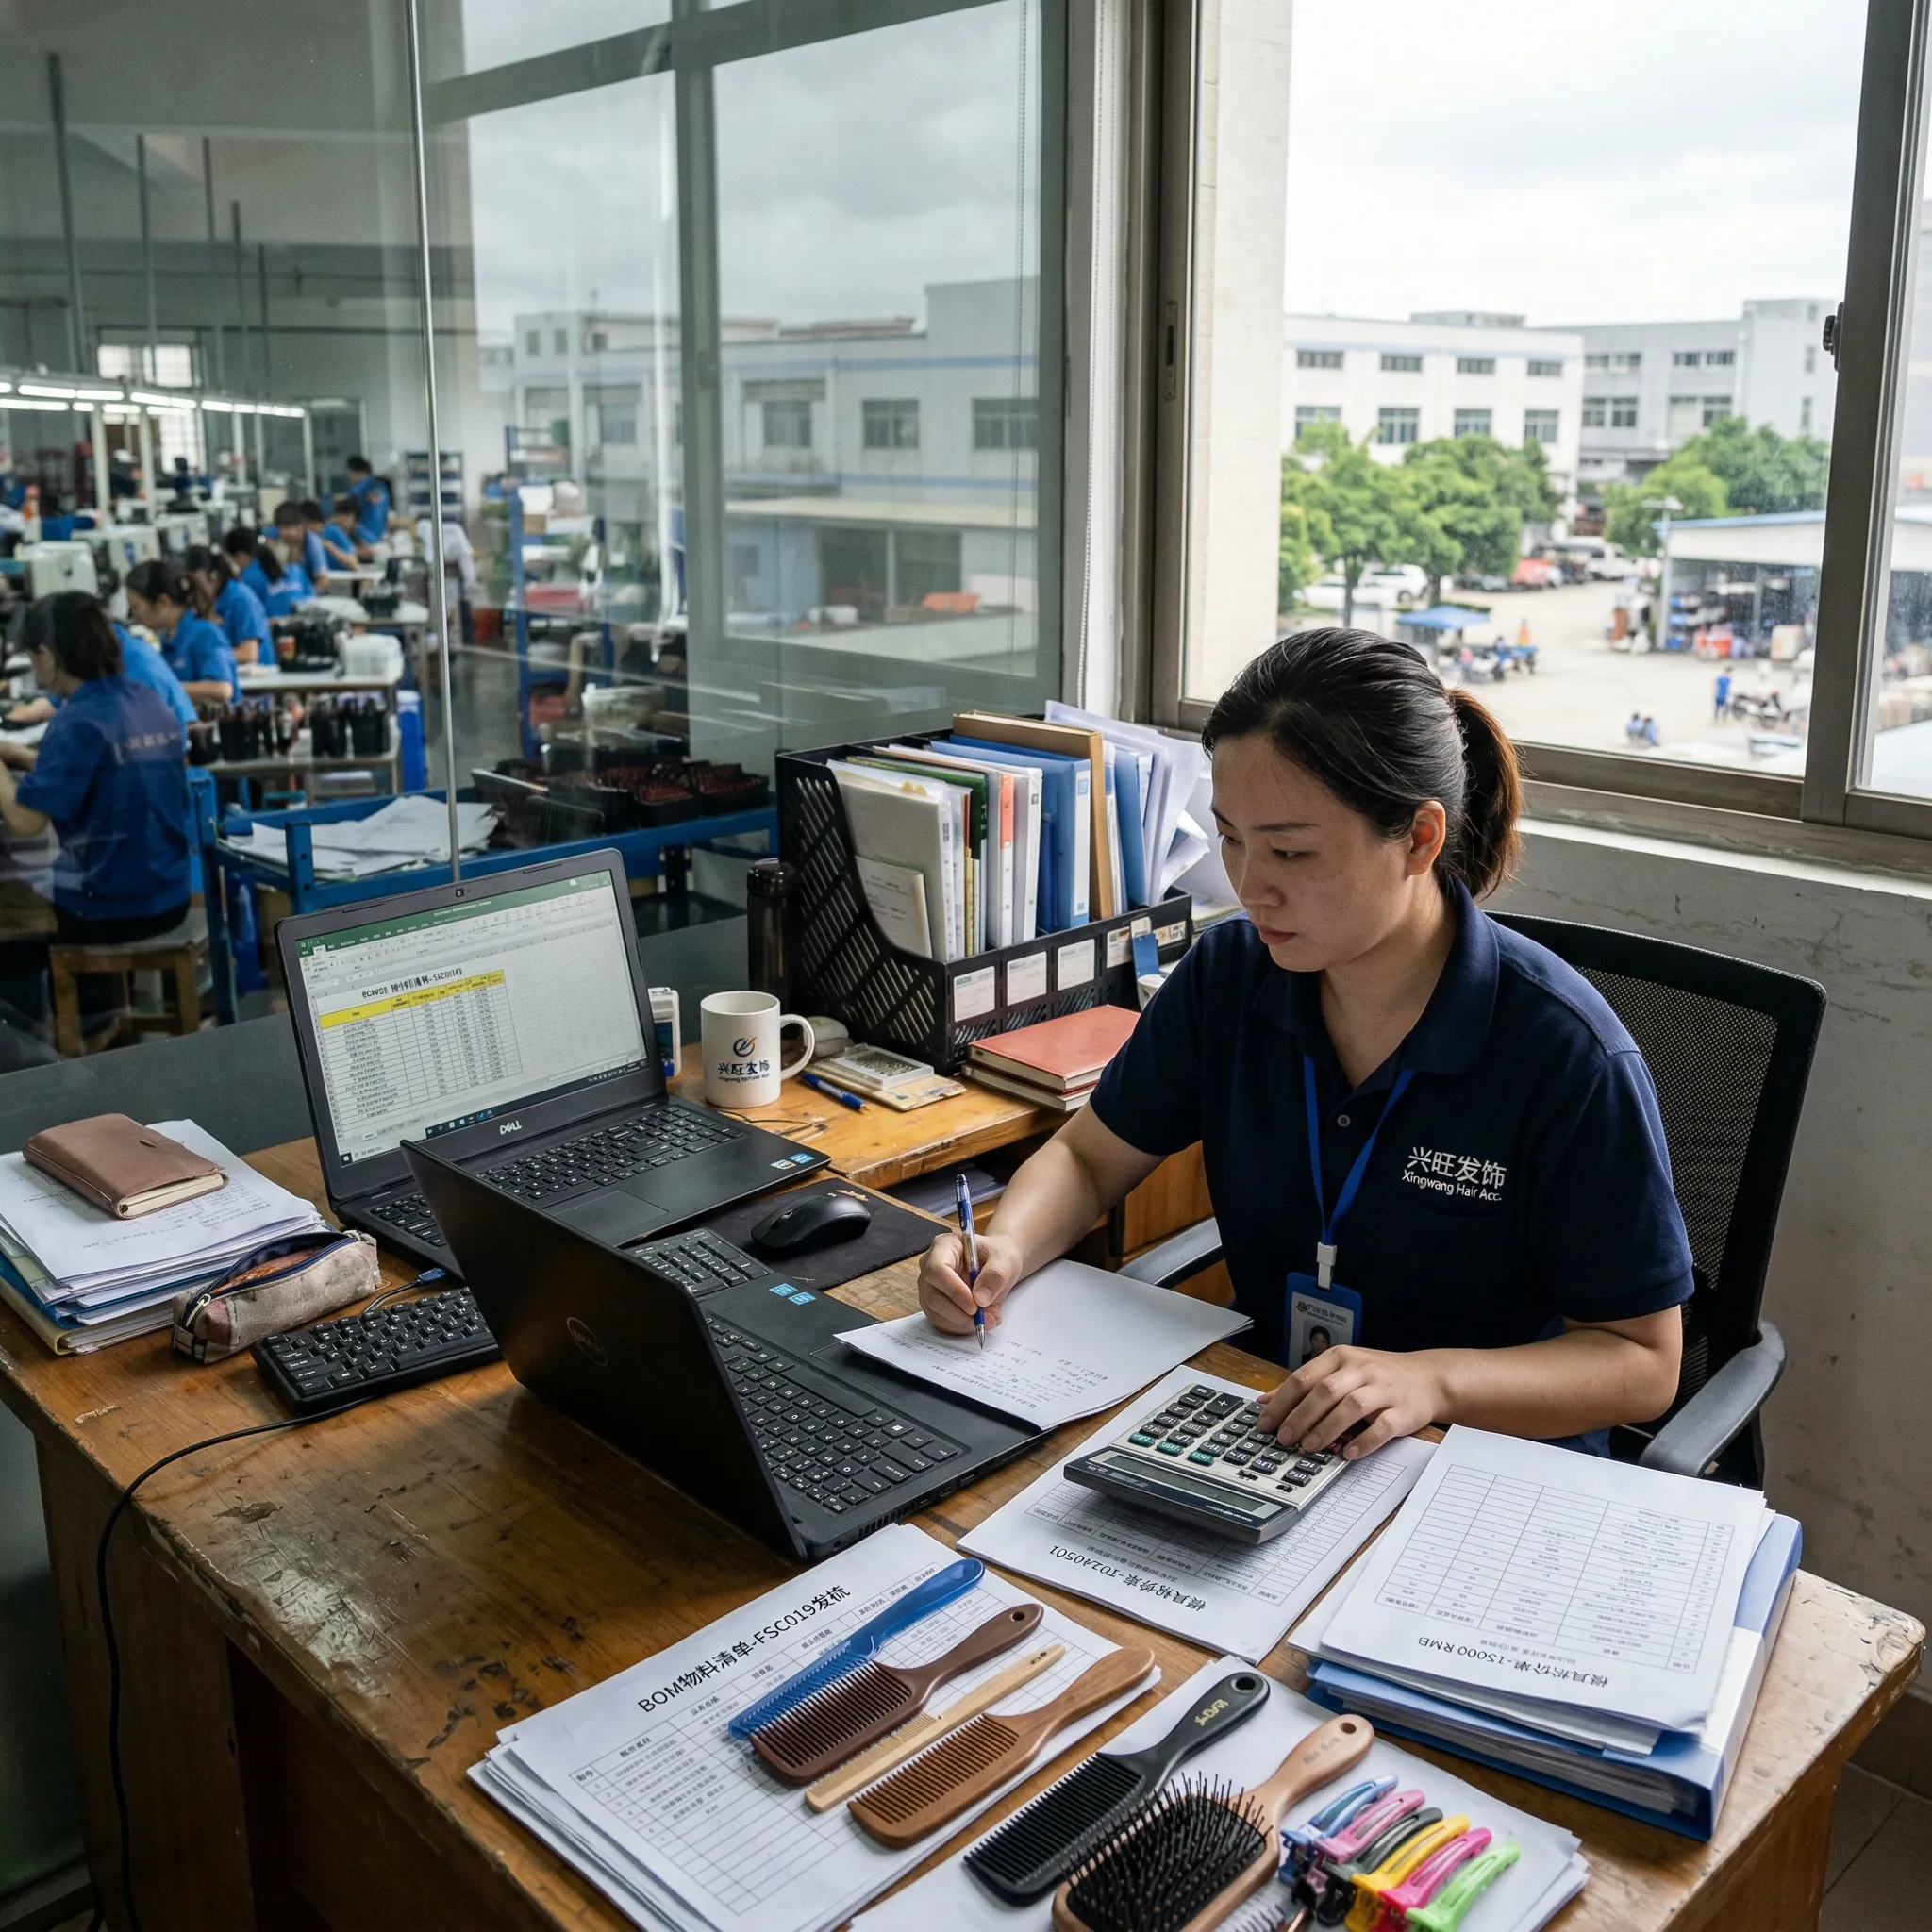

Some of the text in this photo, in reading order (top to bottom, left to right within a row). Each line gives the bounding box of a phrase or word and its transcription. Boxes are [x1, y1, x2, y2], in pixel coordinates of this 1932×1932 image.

[500, 1120, 522, 1135] DELL
[1407, 1146, 1507, 1189] 兴旺发饰
[1402, 1170, 1455, 1195] Xingwang
[1457, 1183, 1478, 1198] Hair
[638, 1585, 851, 1713] BOM物料清单-FSC019发梳
[1418, 1636, 1454, 1654] RMB
